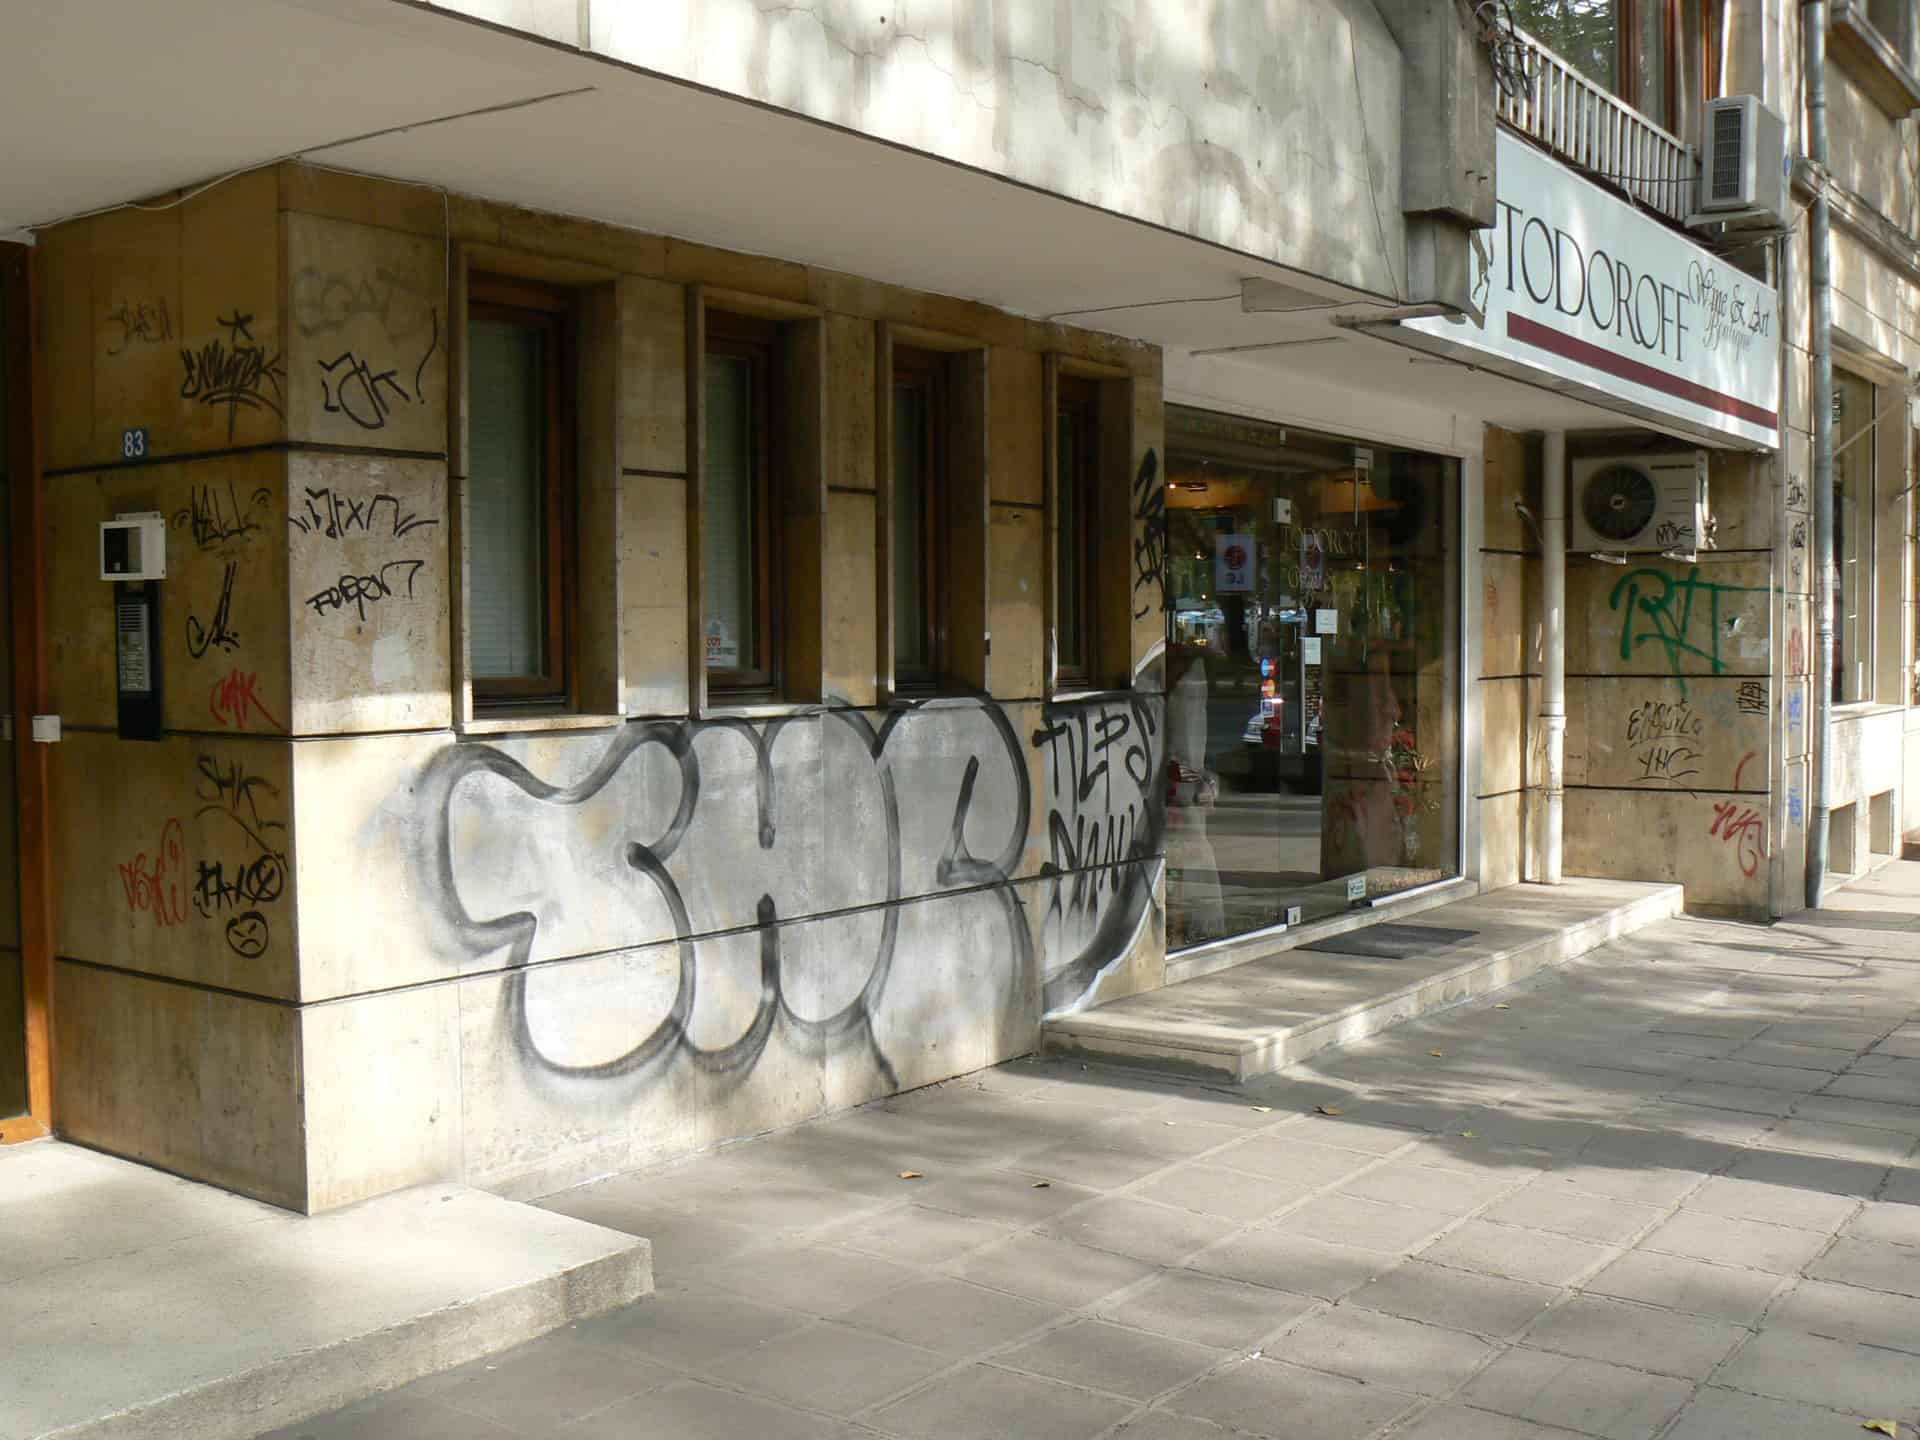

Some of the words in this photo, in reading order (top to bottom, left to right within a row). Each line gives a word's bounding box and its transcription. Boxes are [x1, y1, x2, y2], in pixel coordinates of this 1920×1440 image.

[1496, 199, 1690, 362] TODOROFF
[1730, 284, 1745, 325] &
[123, 431, 145, 457] 83
